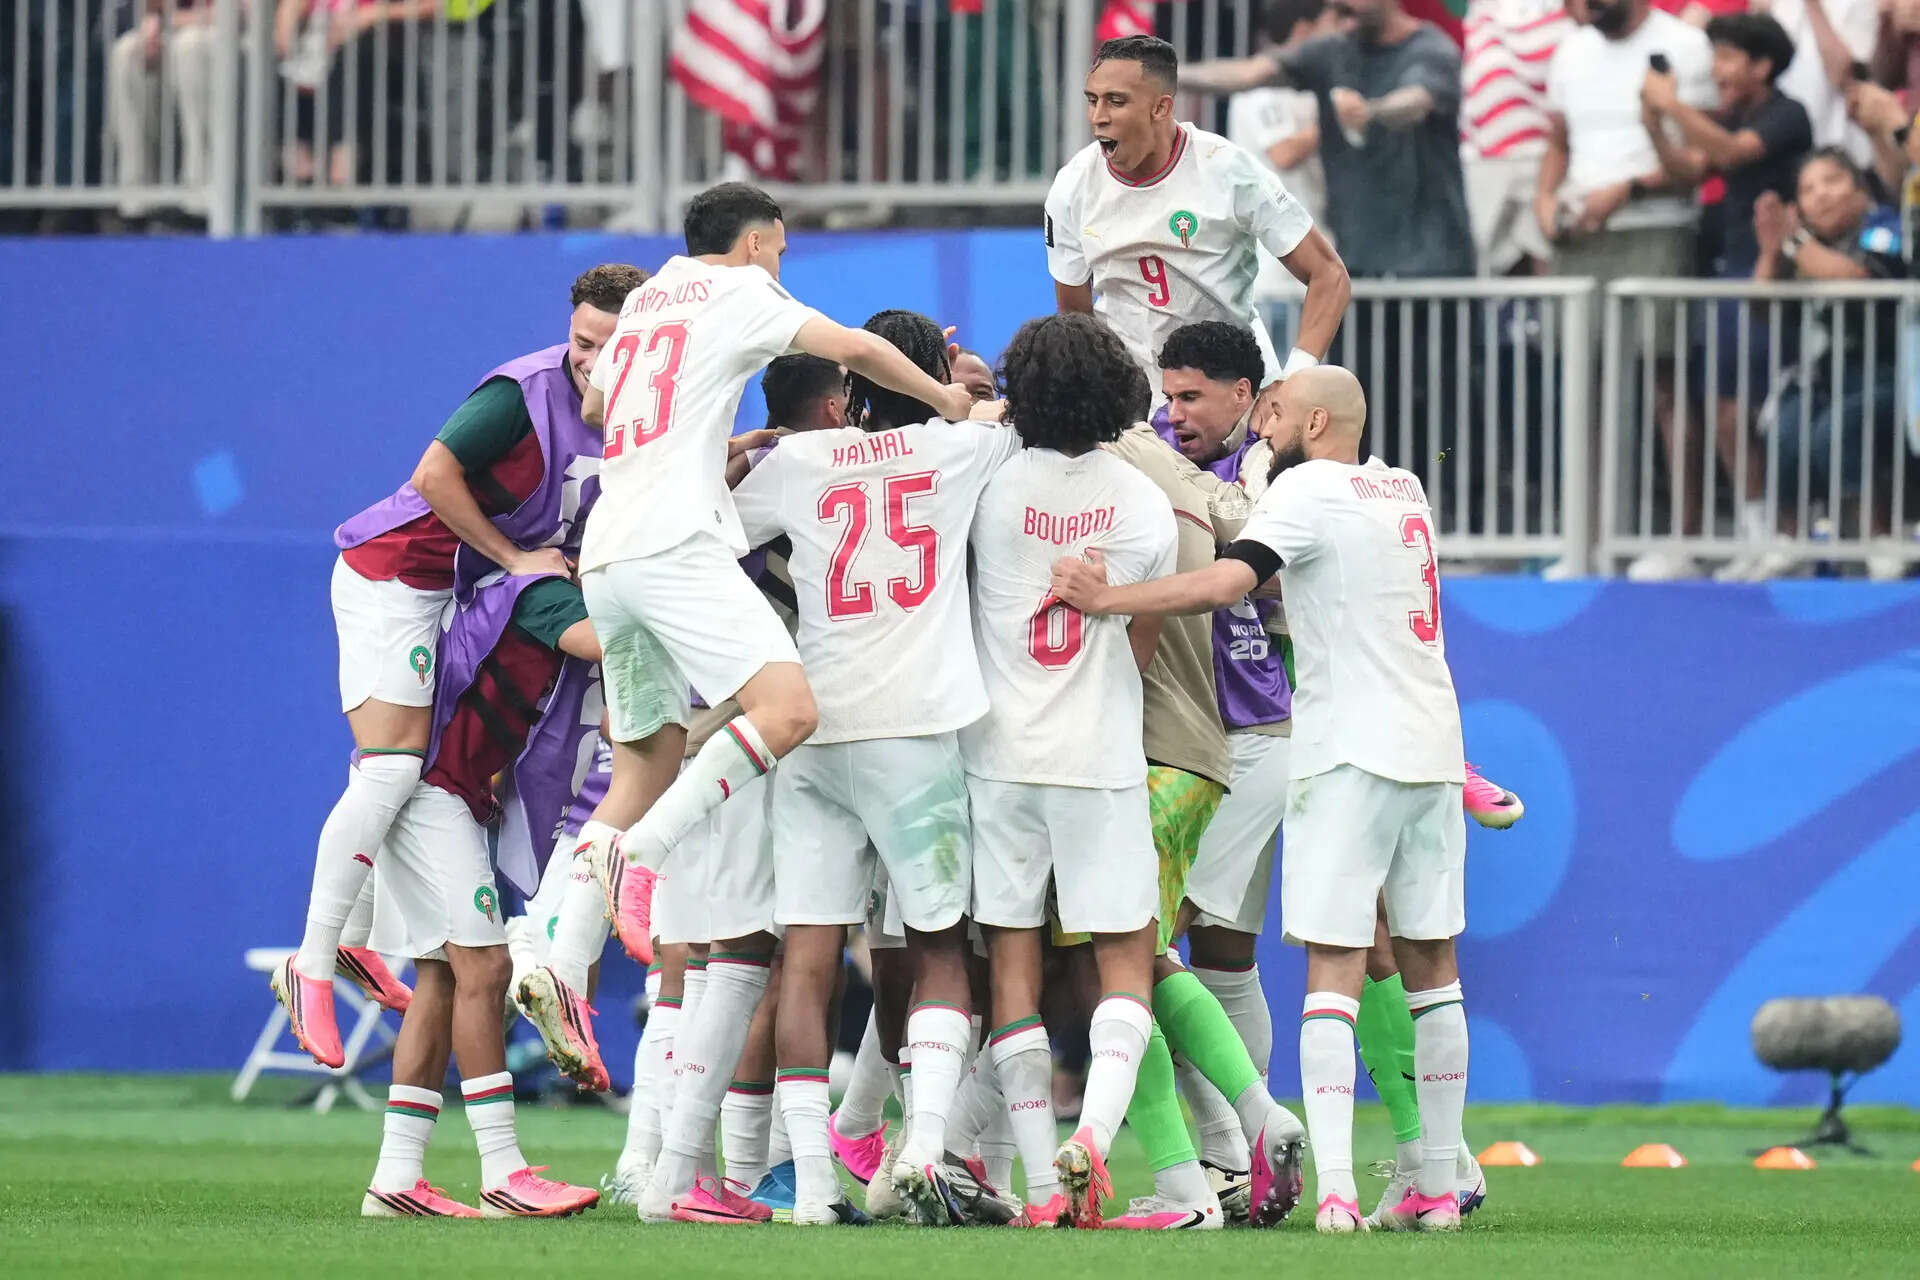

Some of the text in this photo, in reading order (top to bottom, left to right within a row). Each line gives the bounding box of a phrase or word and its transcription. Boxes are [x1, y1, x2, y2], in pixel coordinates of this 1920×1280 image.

[1139, 255, 1171, 307] 9
[604, 319, 693, 461] 23
[831, 431, 913, 467] HALHAL
[817, 469, 942, 622] 25
[1024, 505, 1115, 545] BOUADDI
[1398, 513, 1442, 647] 3
[1230, 639, 1269, 661] 20
